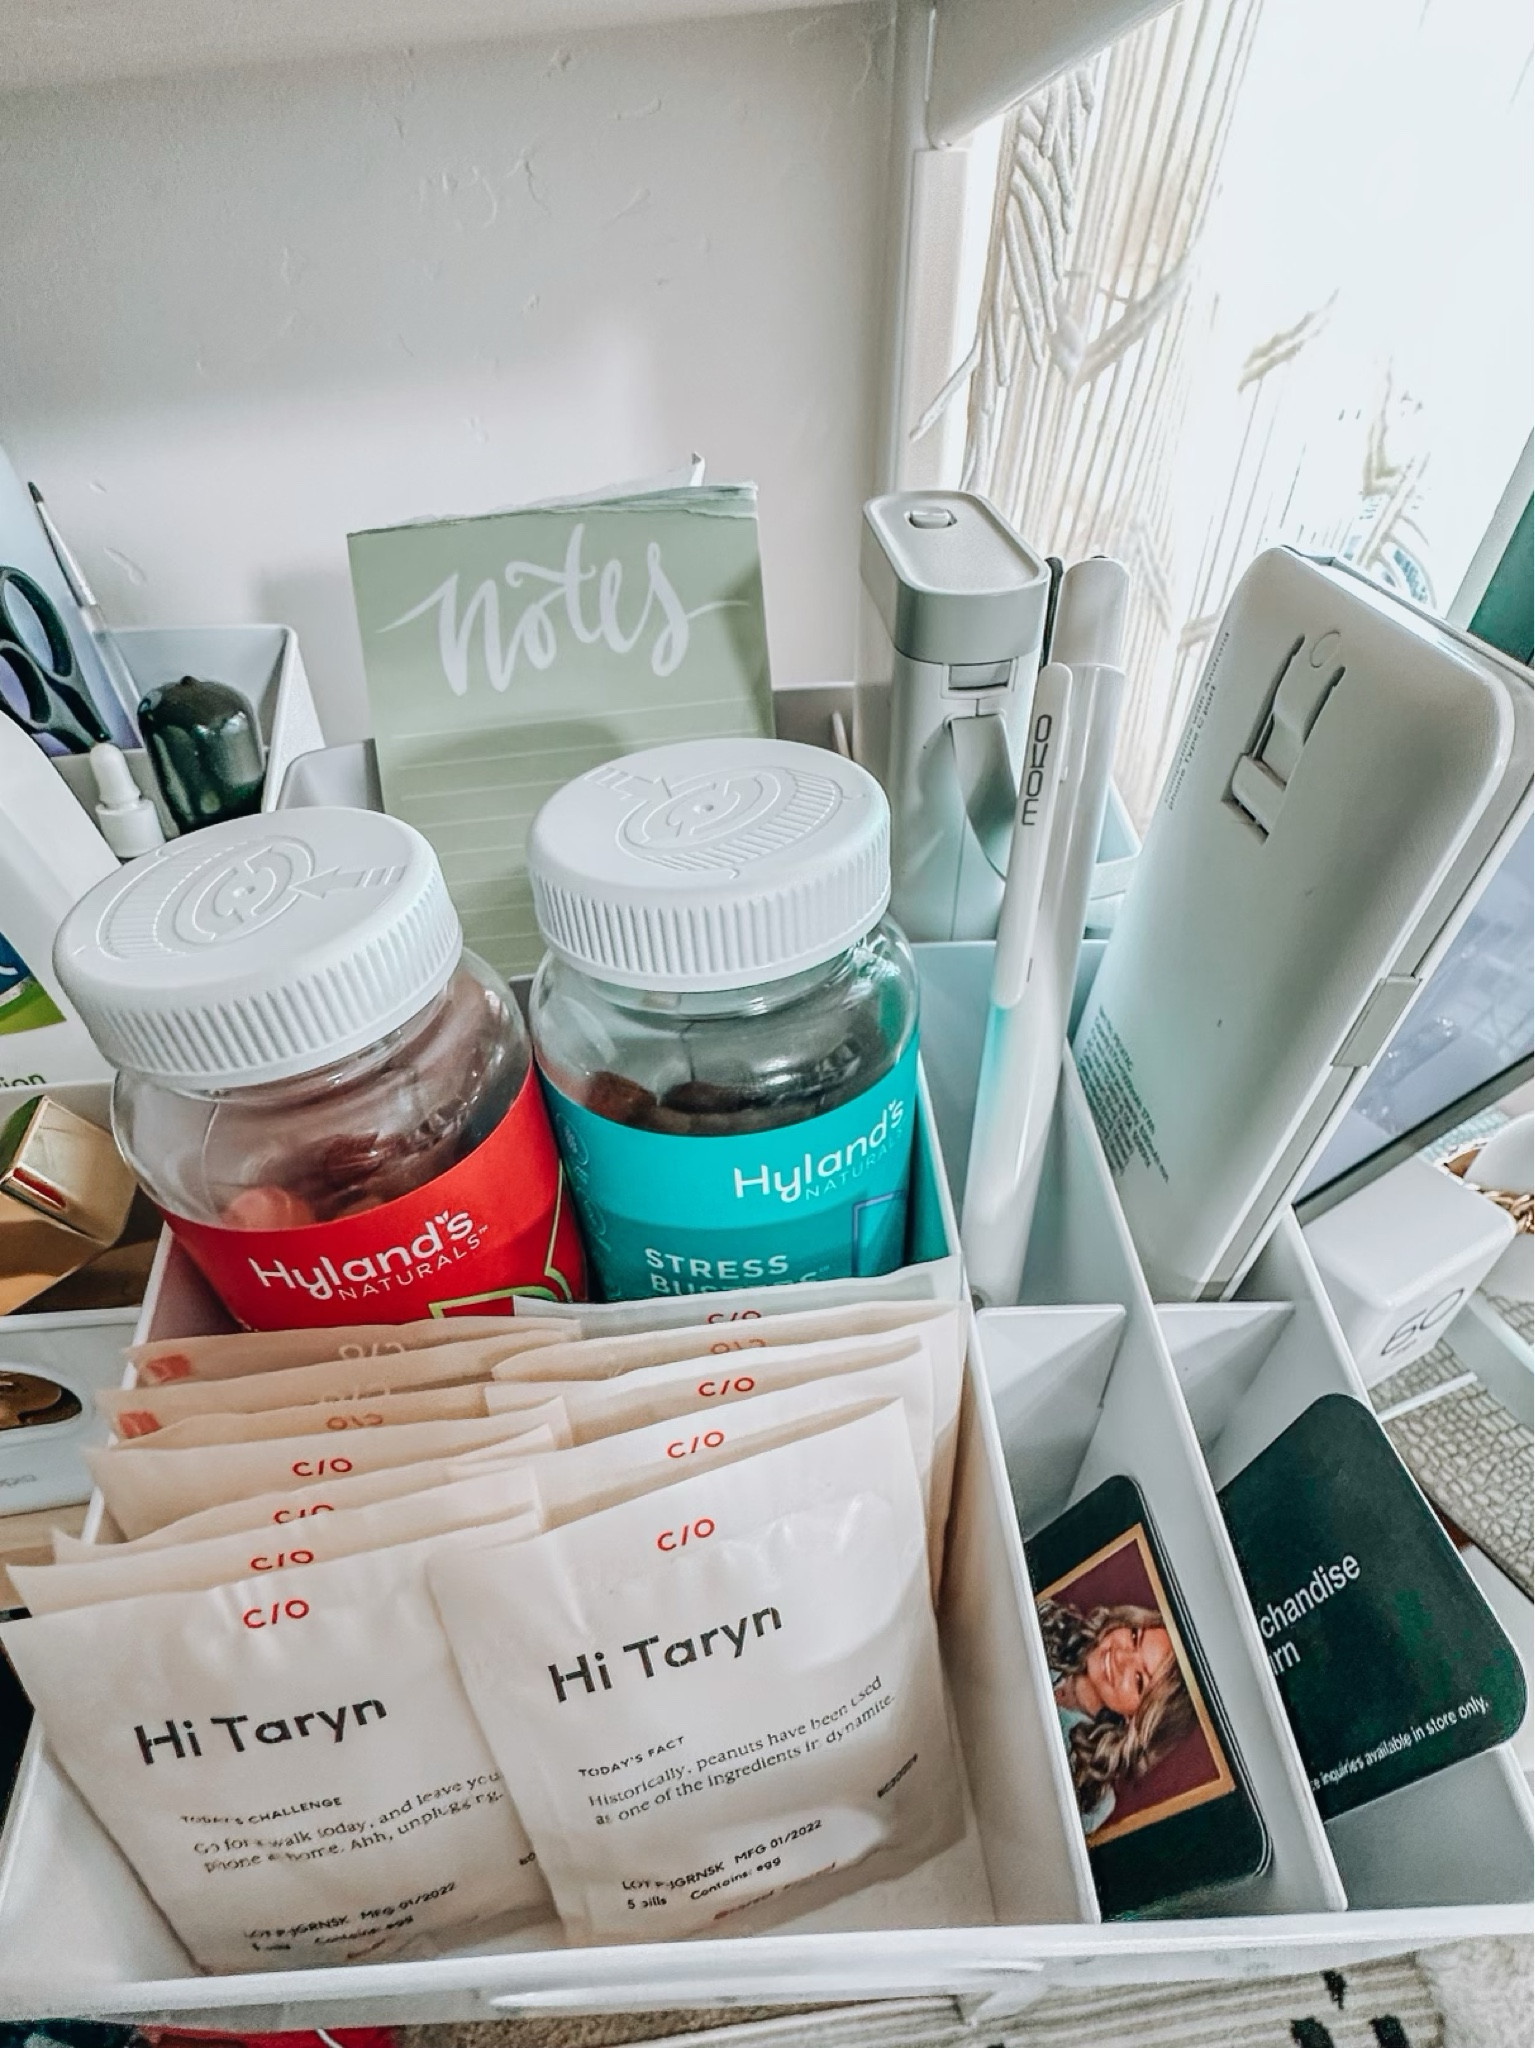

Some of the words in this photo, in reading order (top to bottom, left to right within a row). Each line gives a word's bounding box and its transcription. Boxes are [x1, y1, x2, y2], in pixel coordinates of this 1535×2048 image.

[376, 523, 750, 697] notes
[733, 1099, 905, 1204] Hyland's
[247, 1209, 475, 1301] Hyland's
[644, 1247, 790, 1281] STRESS
[697, 1376, 756, 1397] C/O
[291, 1457, 353, 1477] C/O
[666, 1430, 725, 1459] C/O
[656, 1517, 716, 1552] C/O
[249, 1550, 315, 1571] C/O
[242, 1599, 310, 1629] C/O
[1259, 1554, 1361, 1639] chandise
[547, 1651, 613, 1703] Hi
[622, 1606, 783, 1679] Taryn
[134, 1718, 203, 1766] Hi
[210, 1698, 388, 1753] Taryn
[696, 1738, 764, 1773] peanuts
[767, 1724, 806, 1747] have
[810, 1703, 849, 1731] been
[1363, 1731, 1412, 1766] available
[1410, 1725, 1426, 1743] in
[1425, 1709, 1458, 1736] store
[1457, 1695, 1491, 1720] only.
[577, 1754, 644, 1778] TODAY'S
[647, 1736, 685, 1758] FACT
[378, 1799, 414, 1825] and
[415, 1781, 463, 1807] leave
[618, 1800, 650, 1821] one
[654, 1787, 672, 1806] of
[675, 1777, 704, 1798] the
[708, 1746, 802, 1786] ingredients
[247, 1796, 344, 1825] CHALLENGE
[733, 1843, 767, 1865] MFG
[769, 1818, 823, 1849] 01/2022
